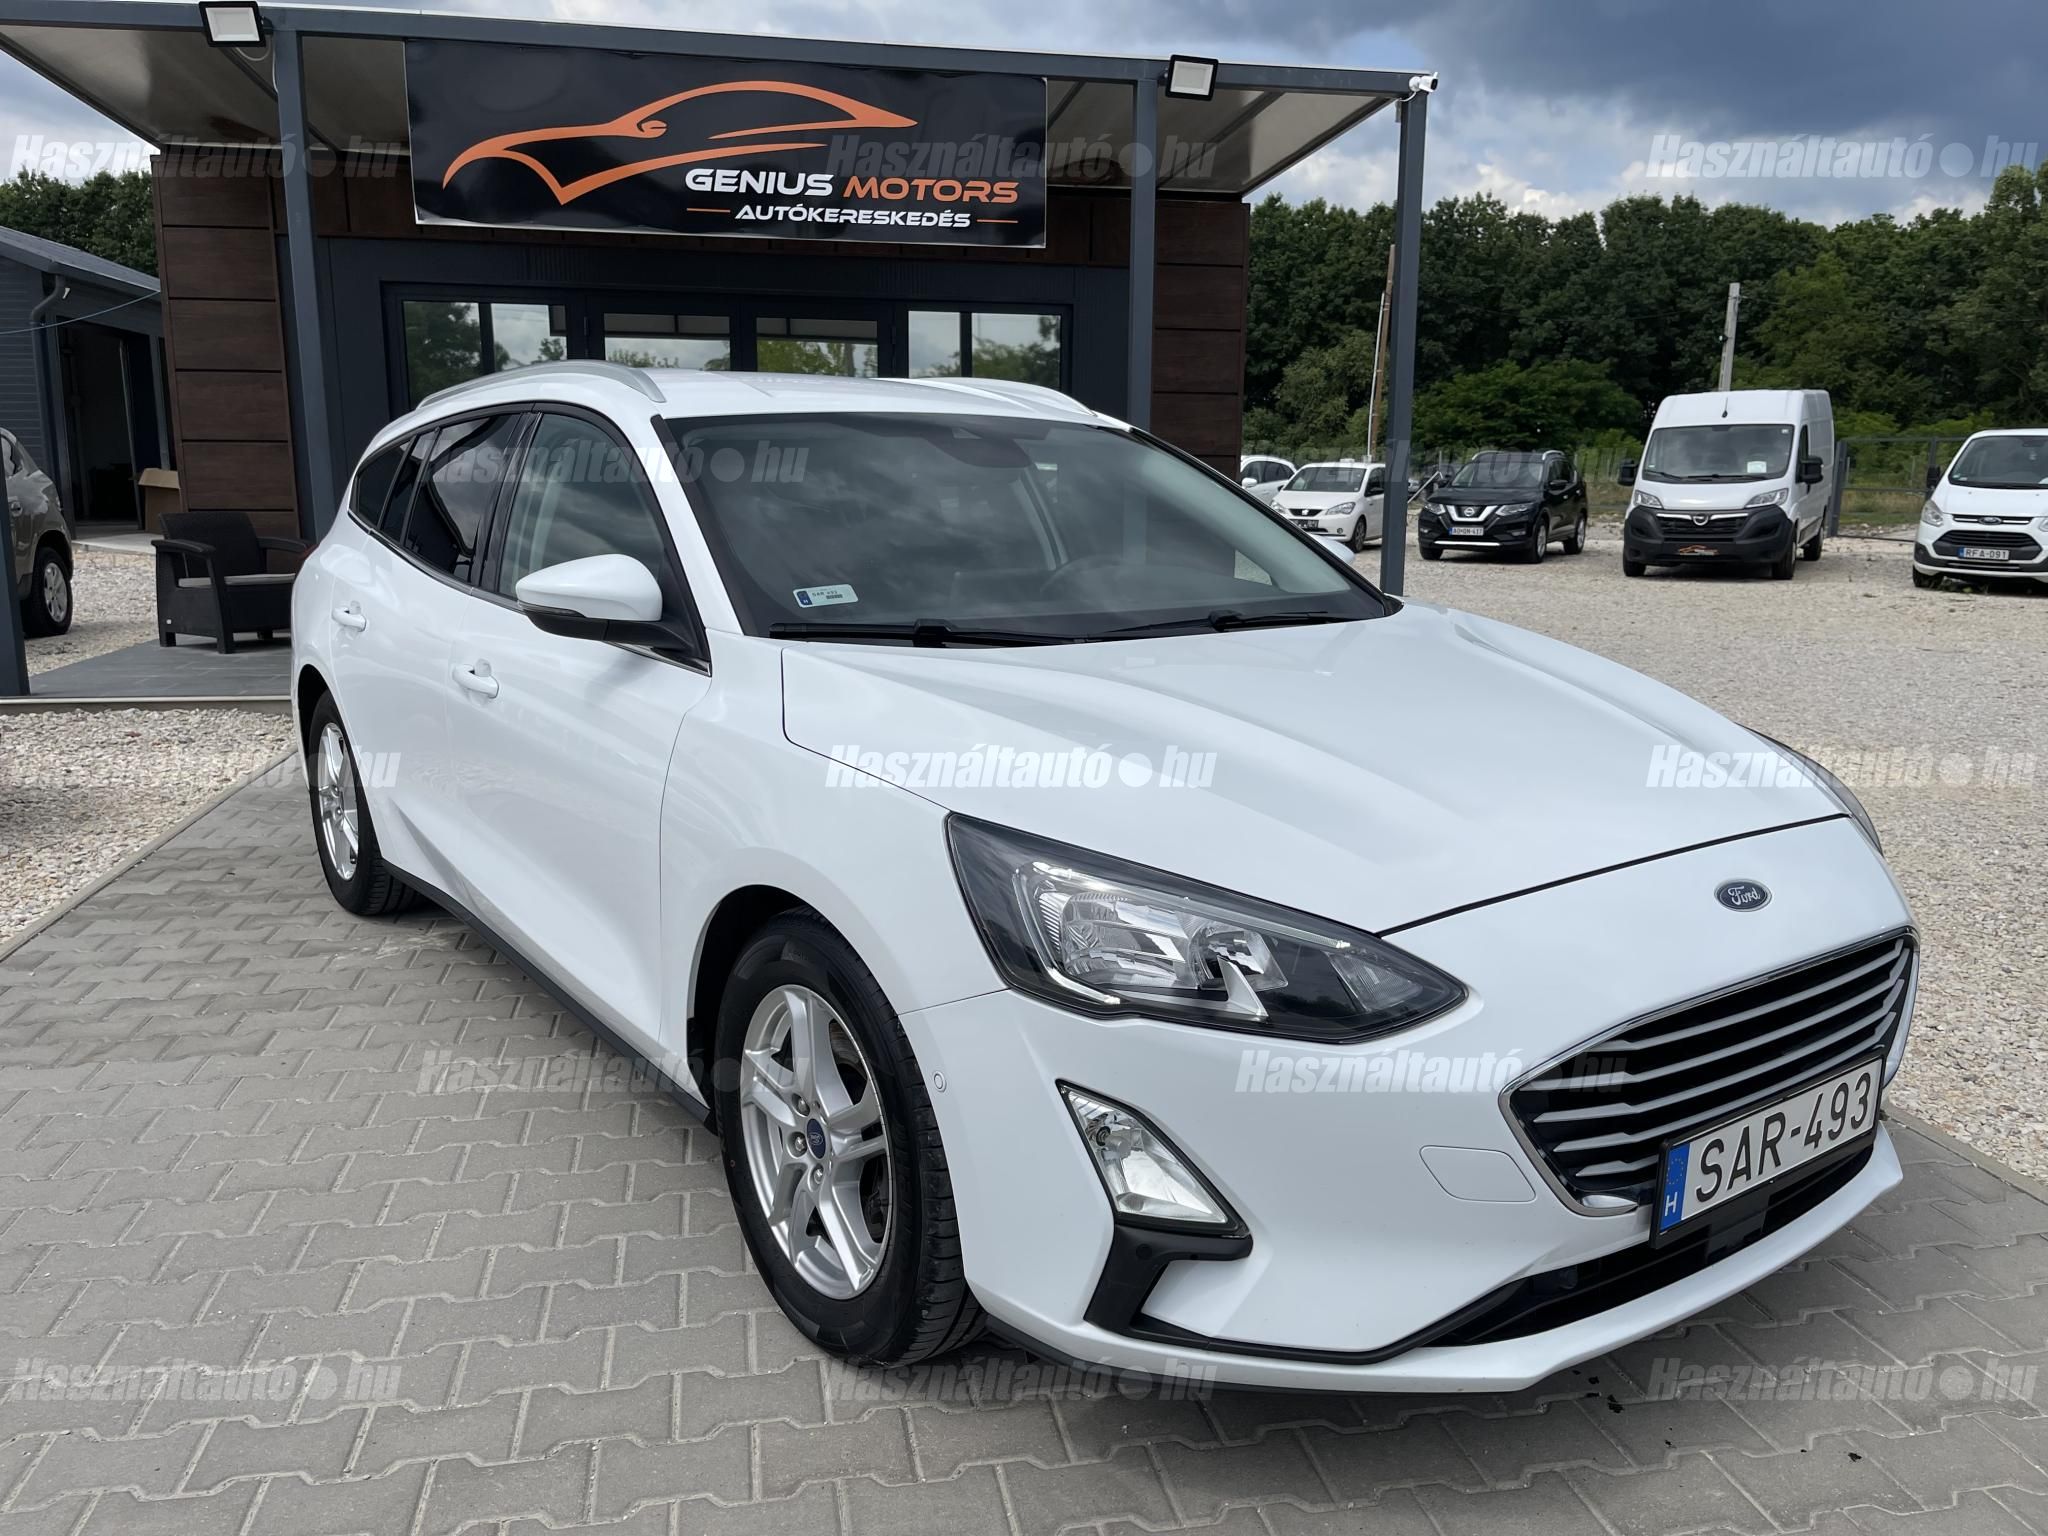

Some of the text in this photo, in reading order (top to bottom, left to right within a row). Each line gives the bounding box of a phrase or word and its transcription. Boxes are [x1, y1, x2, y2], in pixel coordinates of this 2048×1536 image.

[685, 168, 1020, 203] GENIUS MOTORS
[735, 203, 971, 228] AUTÓKERESKEDÉS
[1966, 549, 2007, 559] RFA-091
[1727, 885, 1761, 905] Ford
[1696, 1072, 1872, 1202] SAR-493
[1664, 1191, 1679, 1216] H
